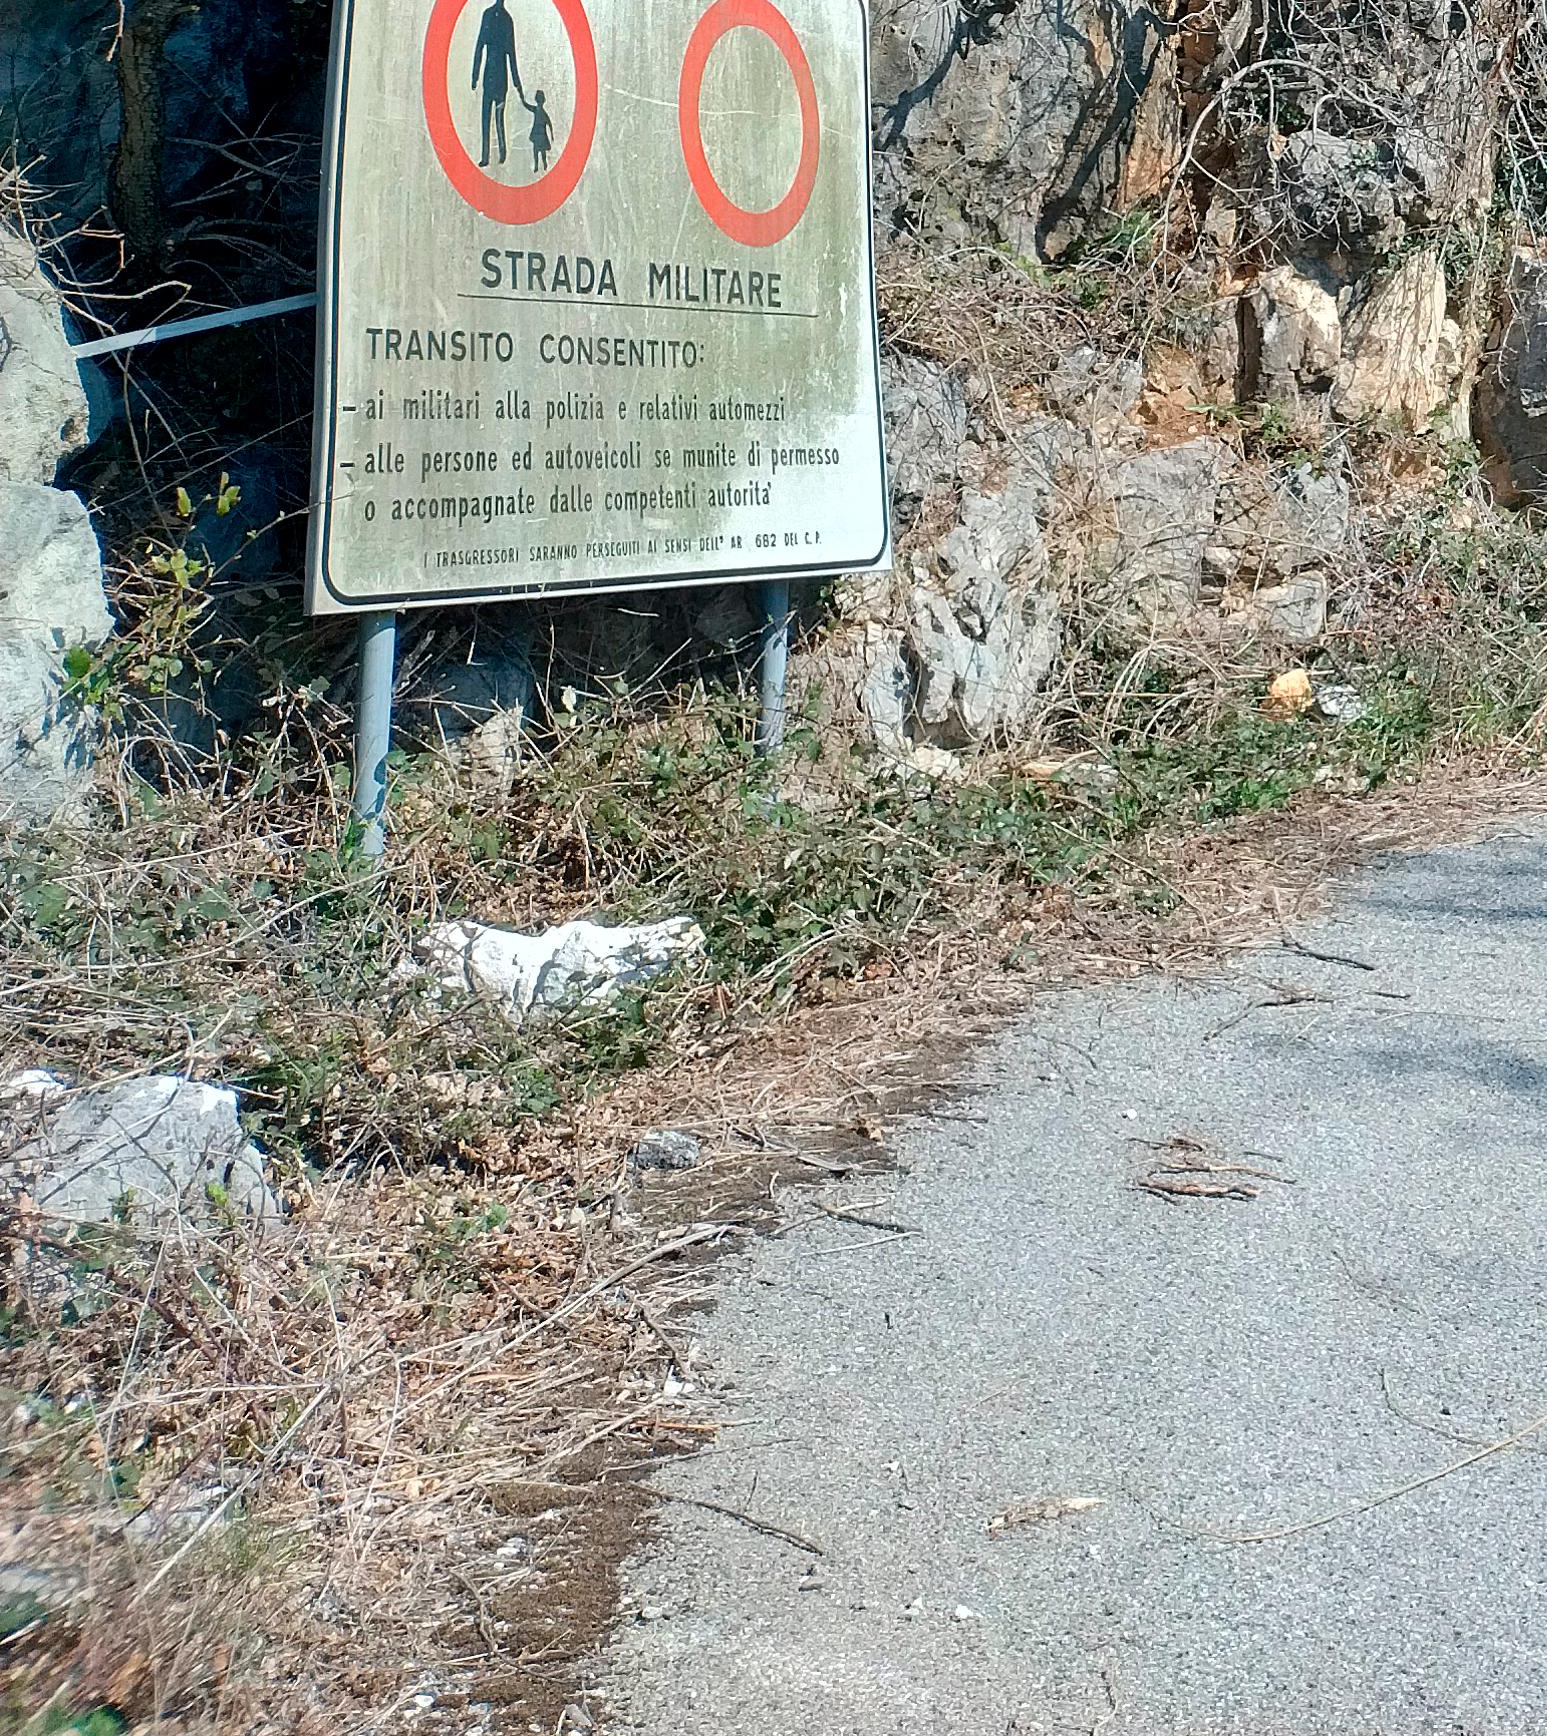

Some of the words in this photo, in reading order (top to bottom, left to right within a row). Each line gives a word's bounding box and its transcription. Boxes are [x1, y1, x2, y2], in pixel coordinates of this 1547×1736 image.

[480, 248, 618, 296] STRADA
[649, 263, 782, 307] MILITARE
[366, 328, 513, 362] TRANSITO
[540, 334, 705, 368] CONSENTITO:
[365, 389, 384, 420] ai
[403, 390, 480, 420] militari
[495, 390, 531, 420] alla
[546, 392, 604, 429] polizia
[618, 400, 627, 420] e
[639, 394, 698, 421] relativi
[709, 397, 785, 422] automezzi
[364, 442, 404, 474] alle
[421, 450, 498, 483] persone
[512, 442, 532, 471] ed
[545, 441, 641, 470] autoveicoli
[654, 450, 671, 468] se
[683, 442, 736, 468] munite
[747, 441, 760, 466] di
[771, 446, 840, 475] permesso
[364, 500, 375, 522] o
[391, 487, 535, 528] accompagnate
[550, 484, 592, 513] dalle
[604, 482, 697, 519] competenti
[436, 548, 520, 568] TRASGRESSORI
[529, 544, 578, 562] SARANNO
[586, 539, 640, 559] PERSEGUITI
[648, 539, 657, 554] AI
[664, 538, 692, 554] SENSI
[755, 533, 777, 548] 682
[784, 532, 798, 547] DEL
